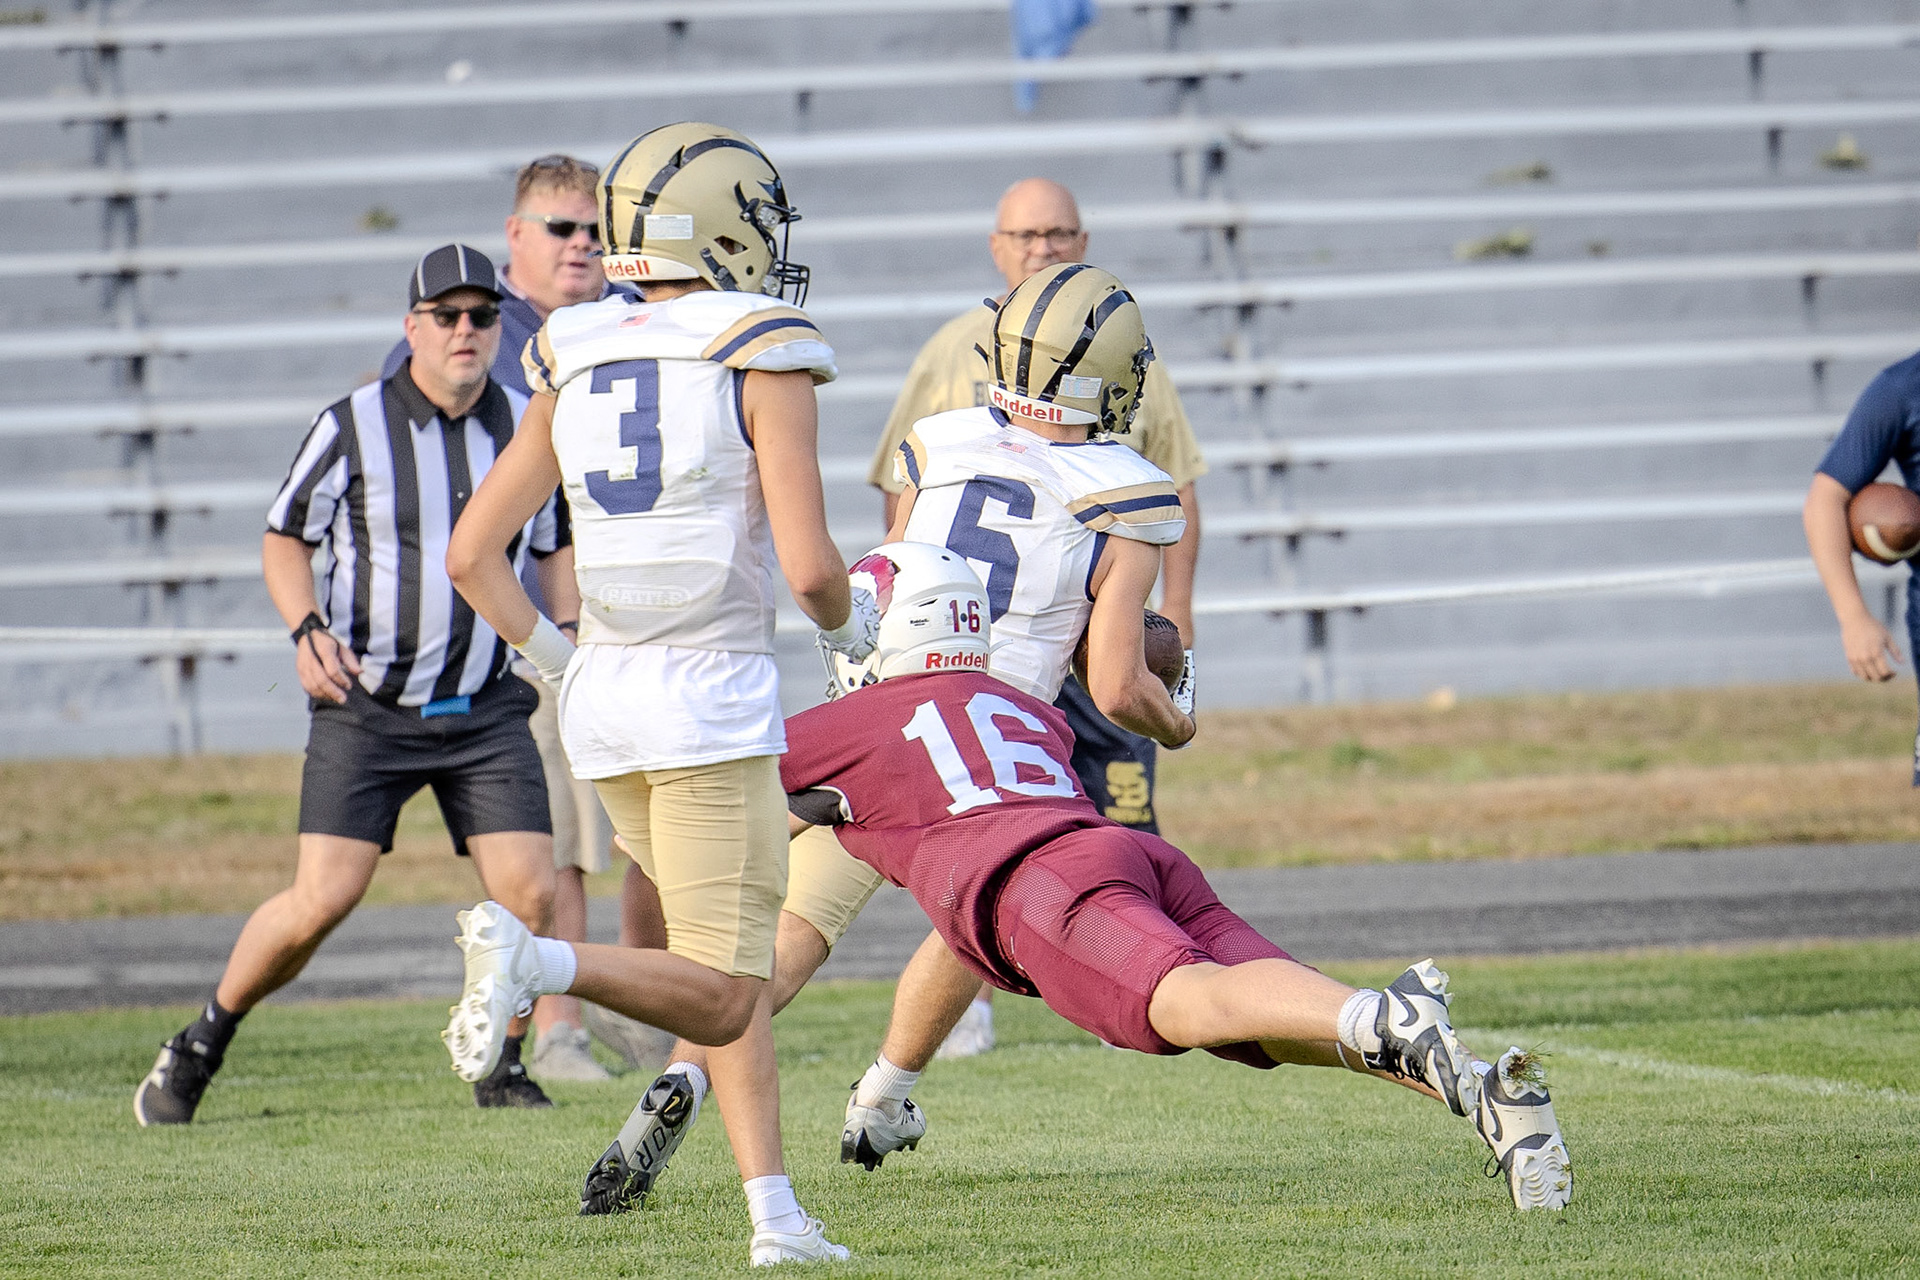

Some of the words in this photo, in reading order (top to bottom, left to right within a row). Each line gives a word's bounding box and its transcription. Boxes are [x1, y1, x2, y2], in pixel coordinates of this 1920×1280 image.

[585, 359, 664, 515] 3
[994, 391, 1062, 422] Riddell
[946, 475, 1036, 623] 6
[949, 600, 980, 633] 16
[925, 651, 988, 670] Riddell
[901, 692, 1079, 815] 16
